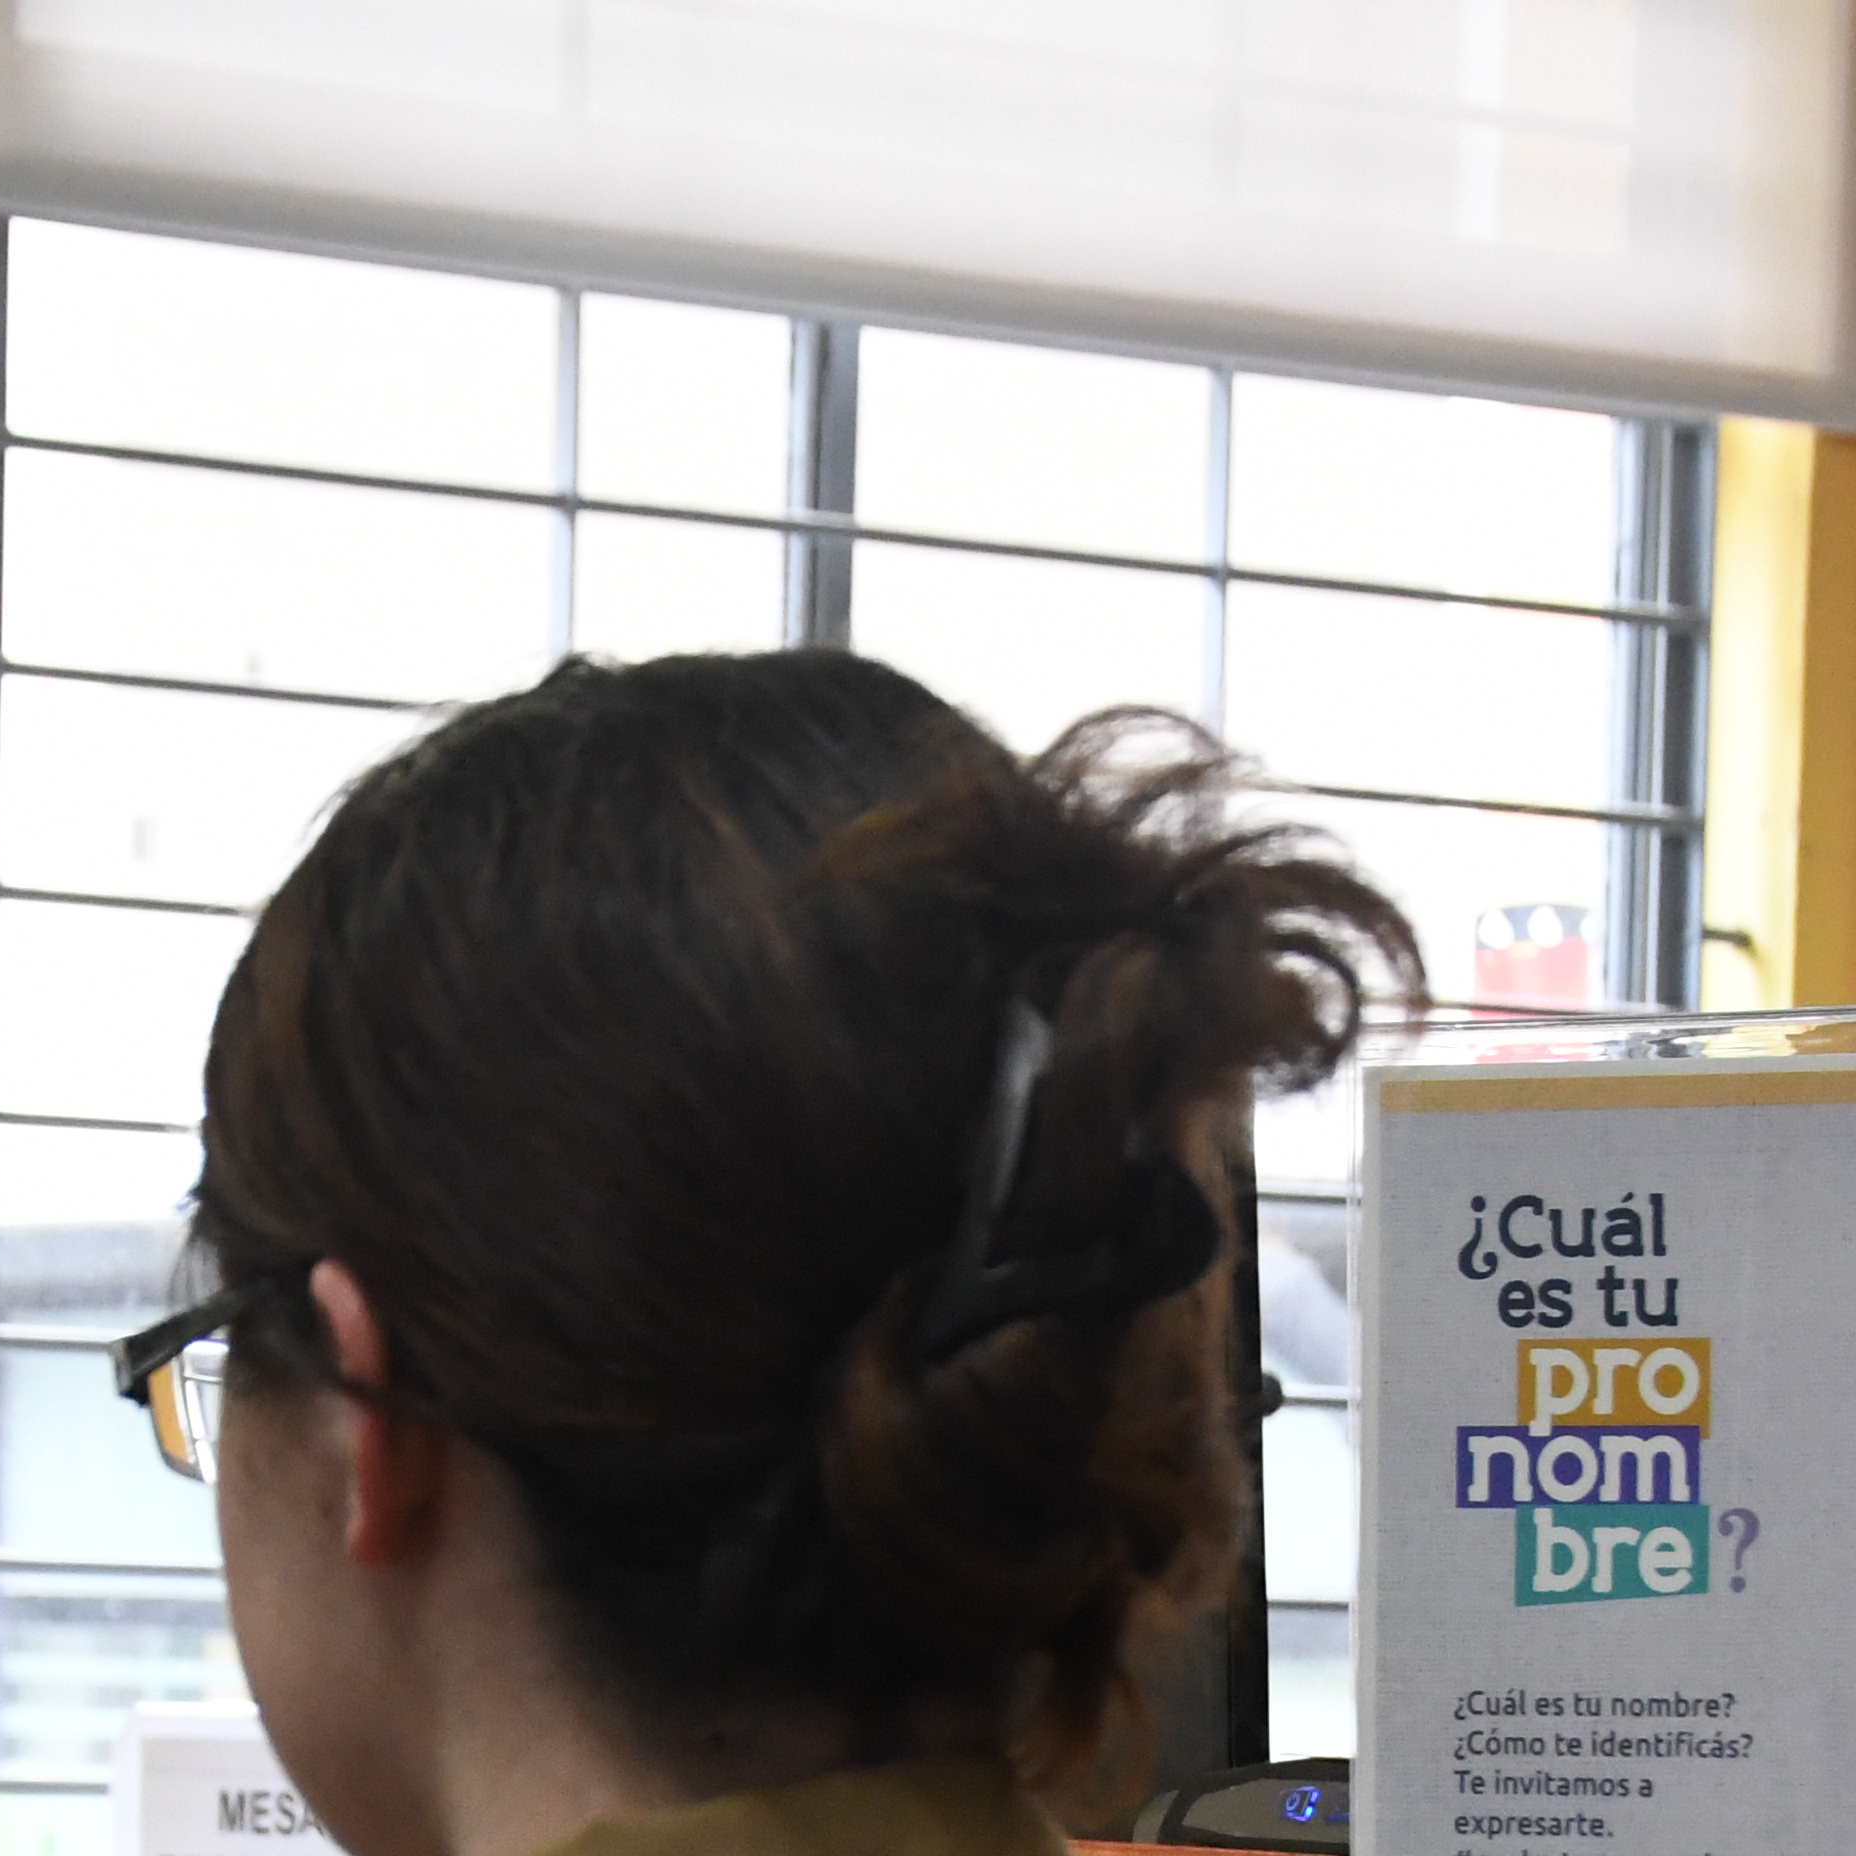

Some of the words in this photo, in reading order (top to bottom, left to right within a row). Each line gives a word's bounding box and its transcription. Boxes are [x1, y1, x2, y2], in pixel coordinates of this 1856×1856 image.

[1458, 1192, 1666, 1280] ¿Cuál
[1498, 1278, 1573, 1328] es
[1597, 1265, 1678, 1327] tu
[1529, 1347, 1701, 1437] pro
[1468, 1434, 1690, 1502] nom
[1454, 1689, 1526, 1720] ¿Cuál
[1535, 1698, 1564, 1716] es
[1574, 1693, 1601, 1716] tu
[1611, 1691, 1735, 1718] nombre?
[1454, 1727, 1544, 1760] ¿Cómo
[1555, 1733, 1582, 1757] te
[1591, 1731, 1754, 1759] identificás?
[1454, 1770, 1485, 1794] Te
[1494, 1770, 1630, 1797] invitamos
[1638, 1778, 1654, 1798] a
[1454, 1813, 1613, 1839] expresarte.
